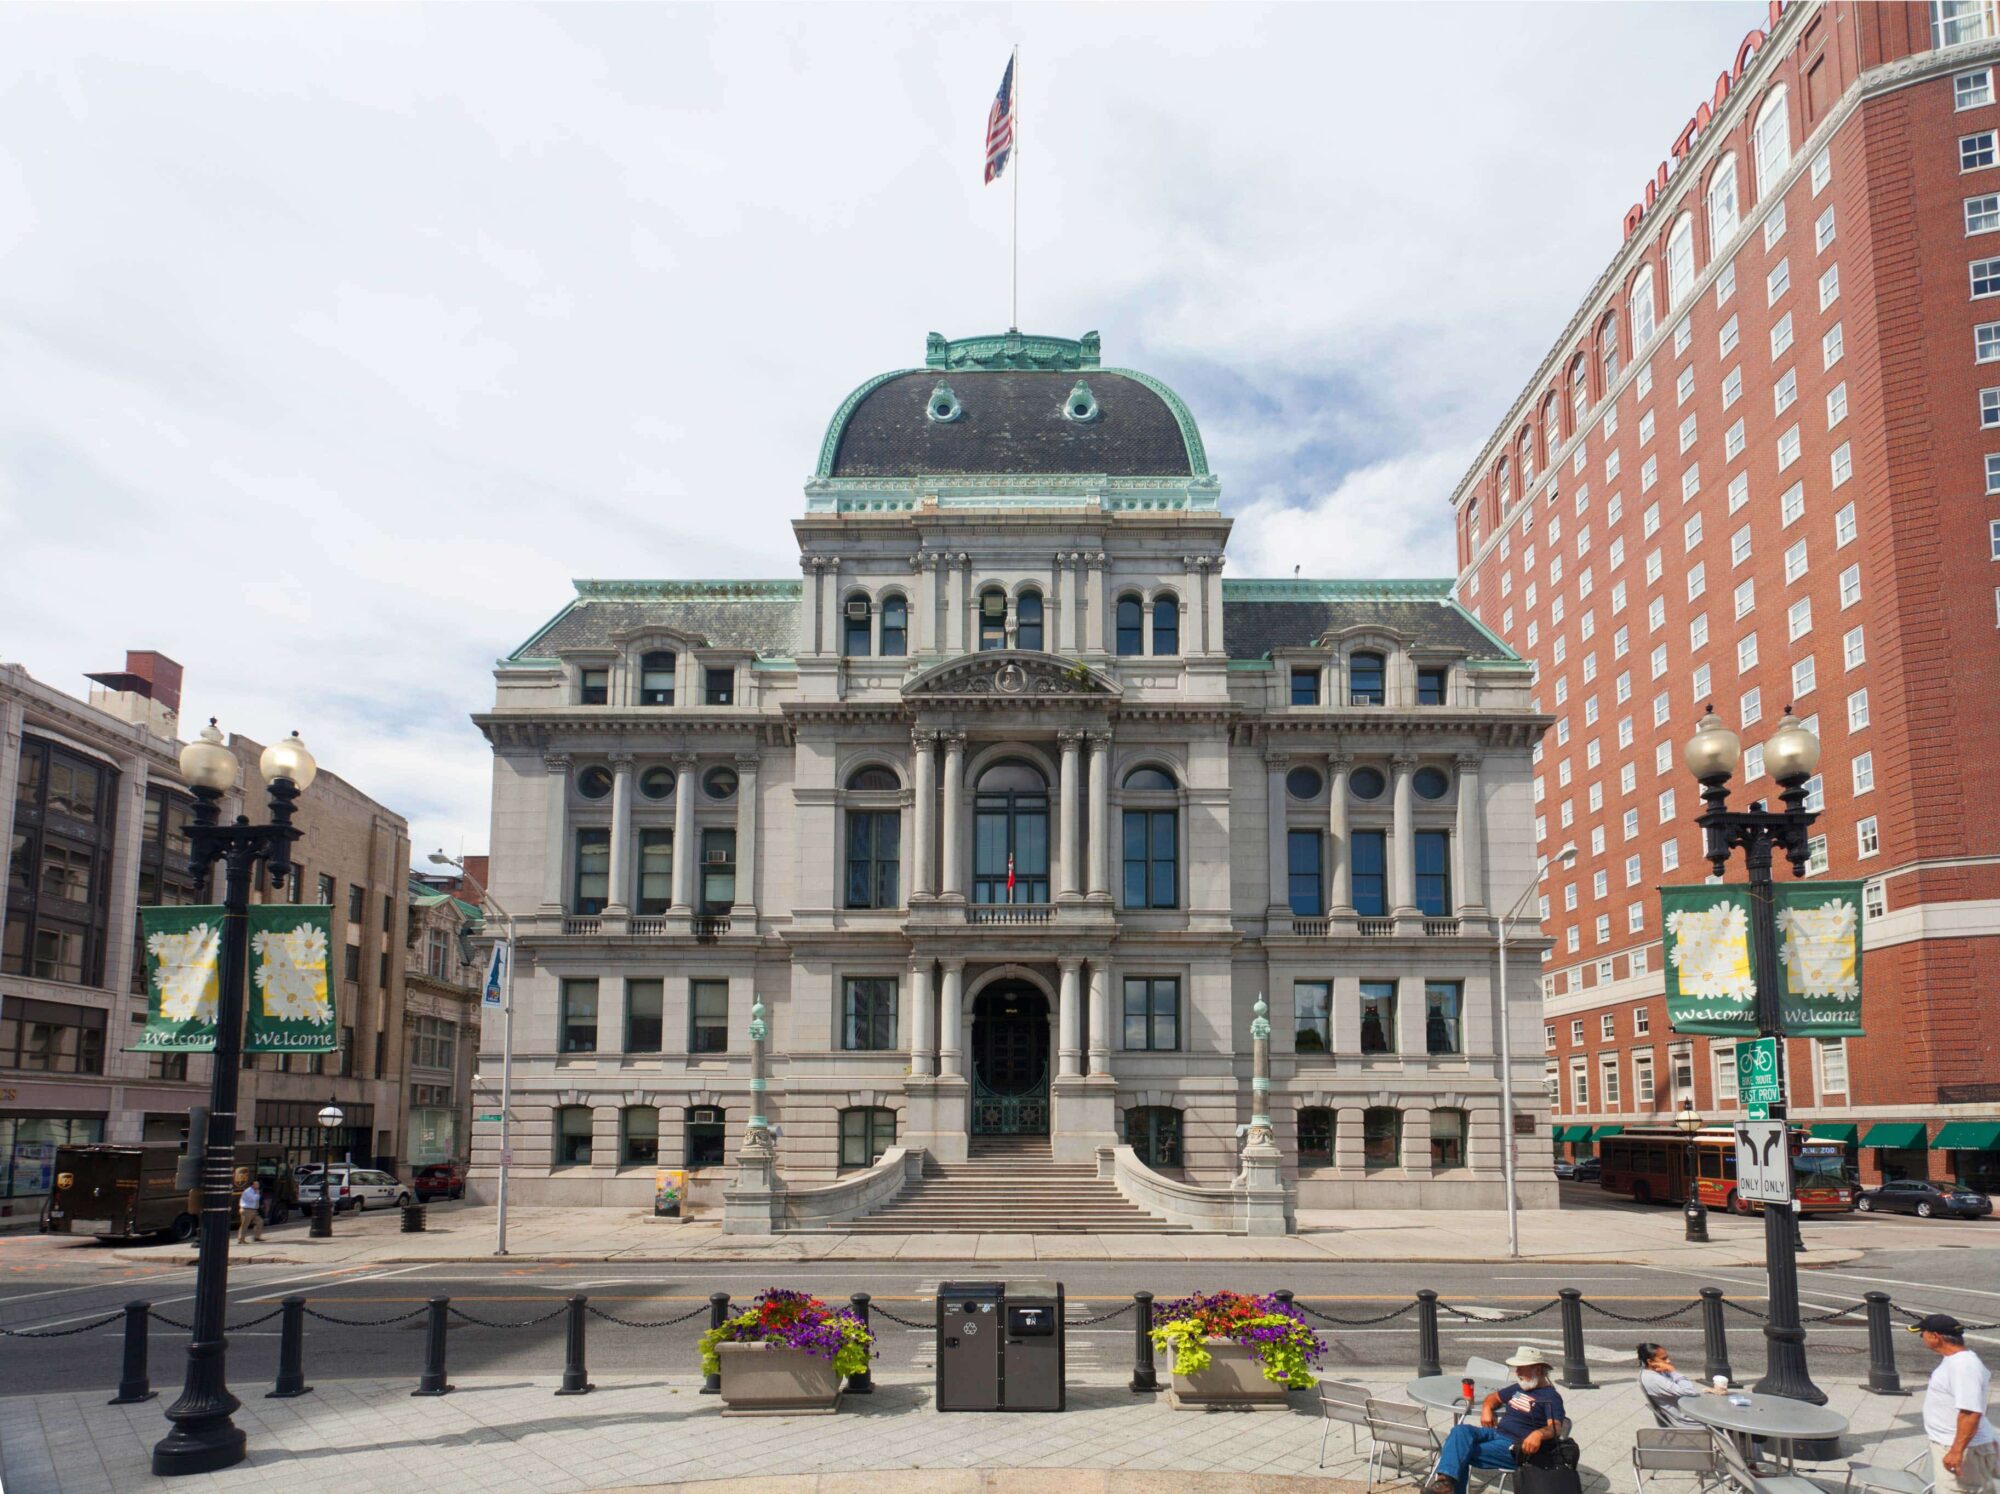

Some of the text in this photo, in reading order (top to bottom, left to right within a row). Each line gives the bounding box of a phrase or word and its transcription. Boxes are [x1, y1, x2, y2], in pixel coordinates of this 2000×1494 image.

[1675, 1008, 1756, 1022] Welcome
[1784, 1008, 1856, 1023] Welcome
[145, 1031, 217, 1046] Welcom
[255, 1031, 335, 1046] Welcome
[1740, 1088, 1777, 1103] EAST PROV
[1740, 1177, 1759, 1191] ONLY
[1764, 1179, 1785, 1193] ONLY
